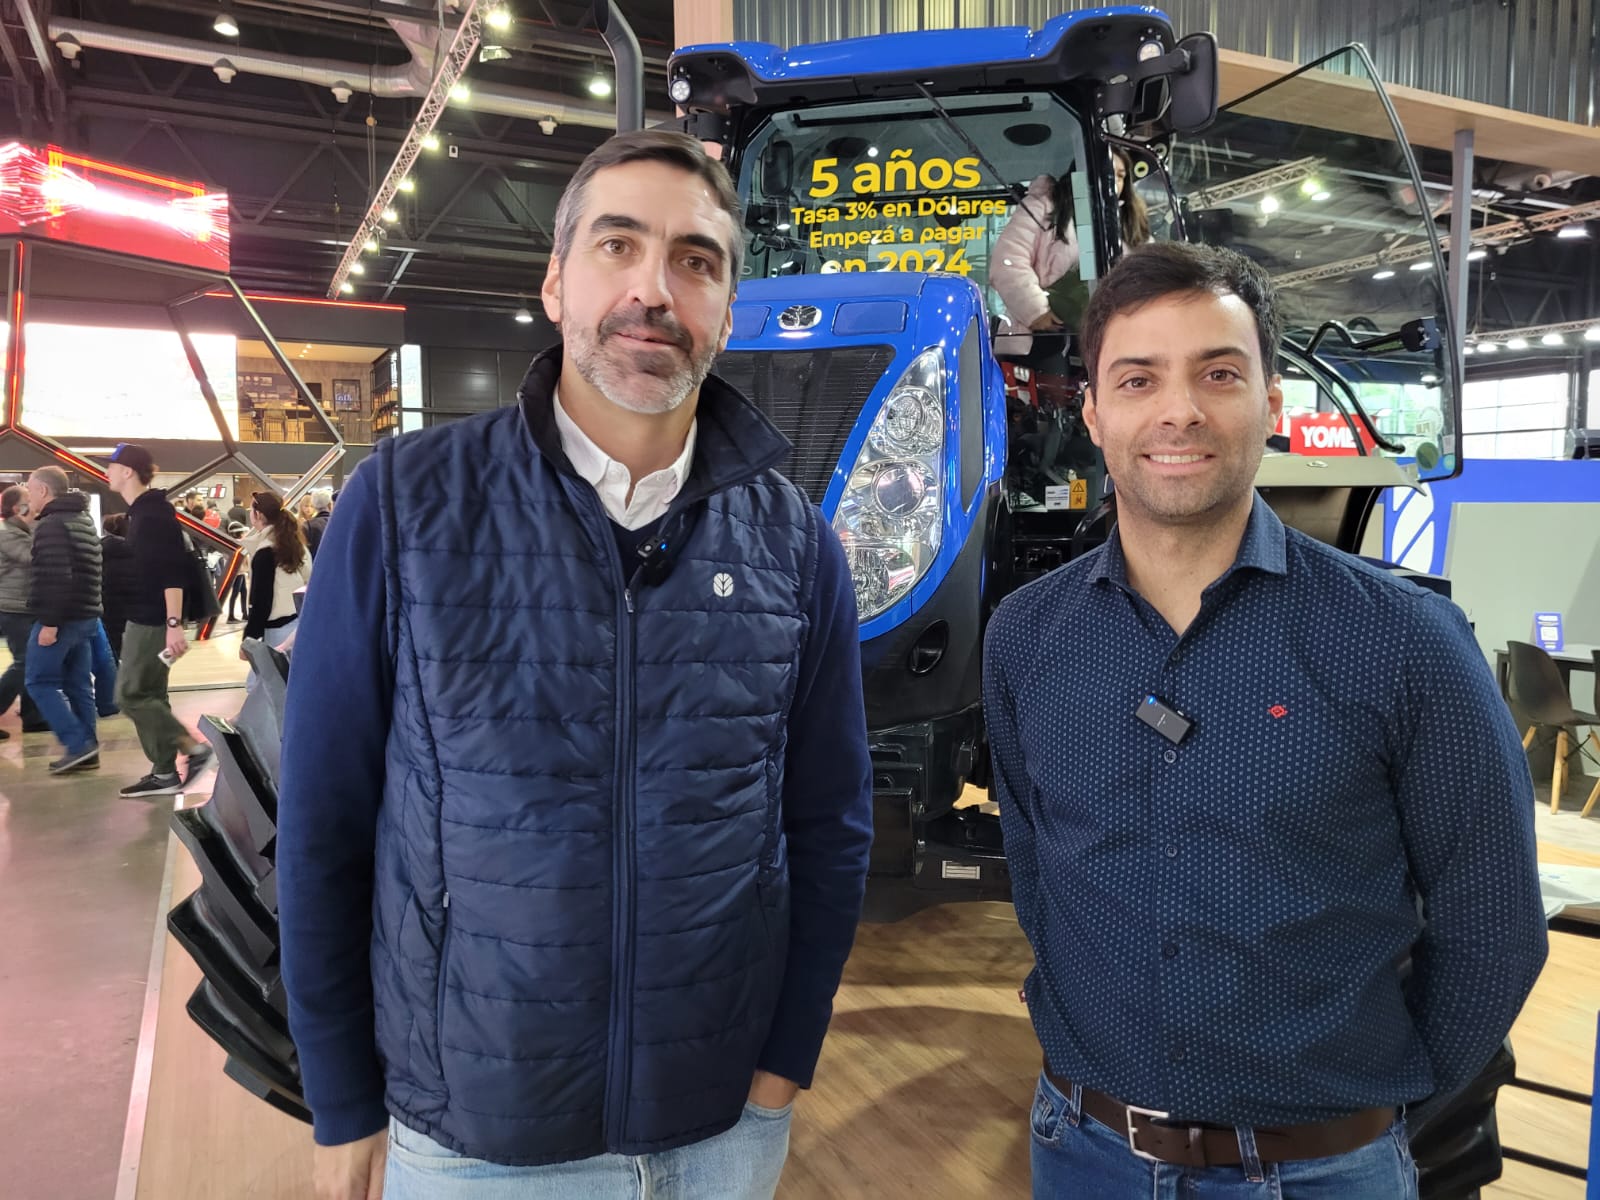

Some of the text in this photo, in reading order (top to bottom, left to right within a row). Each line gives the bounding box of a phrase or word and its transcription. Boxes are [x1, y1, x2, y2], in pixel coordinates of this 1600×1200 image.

[808, 148, 982, 199] 5 años
[791, 195, 1007, 225] Tasa 3% en Dólares
[809, 224, 986, 249] Empezá a pagar
[875, 247, 973, 276] 2024
[1300, 426, 1361, 448] YOME
